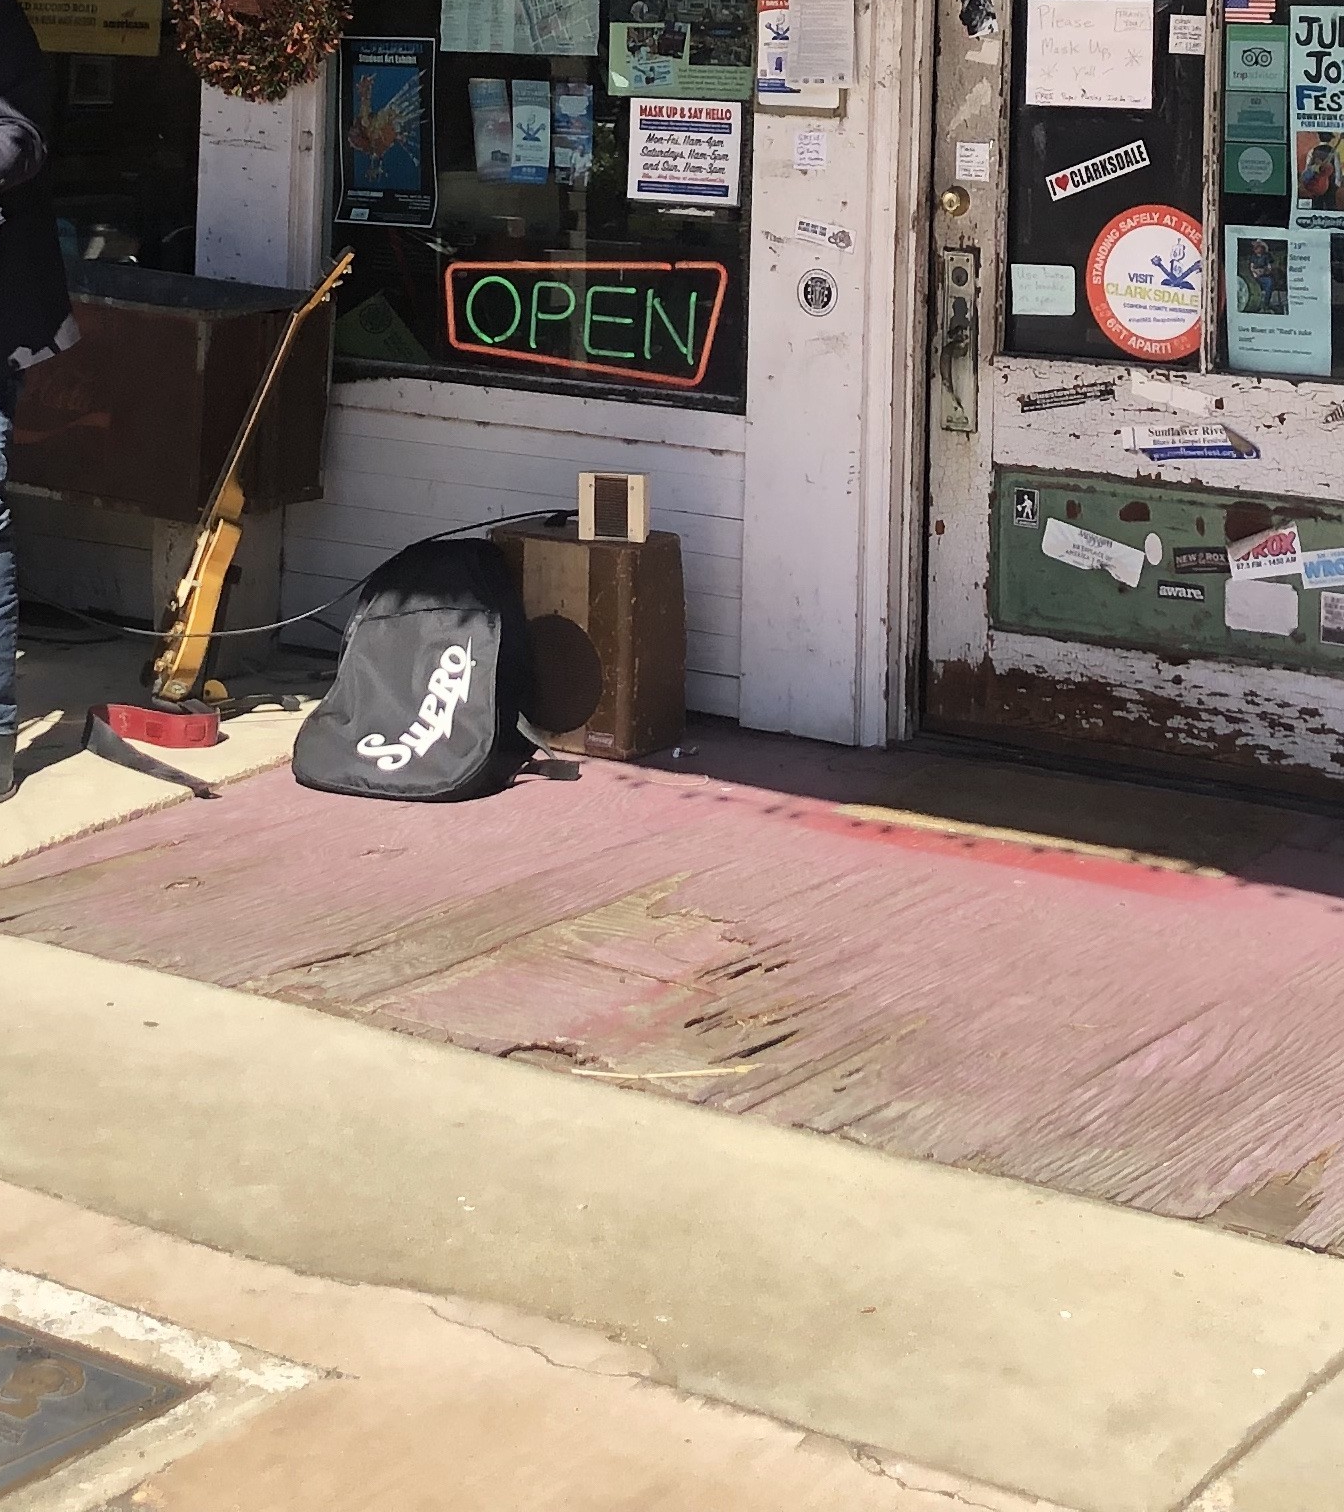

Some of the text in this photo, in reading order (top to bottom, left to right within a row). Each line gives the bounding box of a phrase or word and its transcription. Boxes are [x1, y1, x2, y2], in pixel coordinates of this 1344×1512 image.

[1037, 4, 1096, 29] Please
[639, 104, 732, 121] MASK UP & SAY HELLO
[642, 160, 660, 171] and
[1049, 144, 1147, 196] I CLARKSDALE
[1092, 212, 1203, 285] STANDING SAFELY AT THE
[1127, 272, 1155, 285] VISIT
[1105, 283, 1199, 307] CLARKSDALE
[466, 275, 697, 365] OPEN
[1106, 317, 1127, 339] 6FT
[1148, 425, 1226, 437] Sunflower Rive
[1175, 554, 1197, 565] NEW
[1285, 556, 1297, 565] AM
[1158, 583, 1204, 601] aware.
